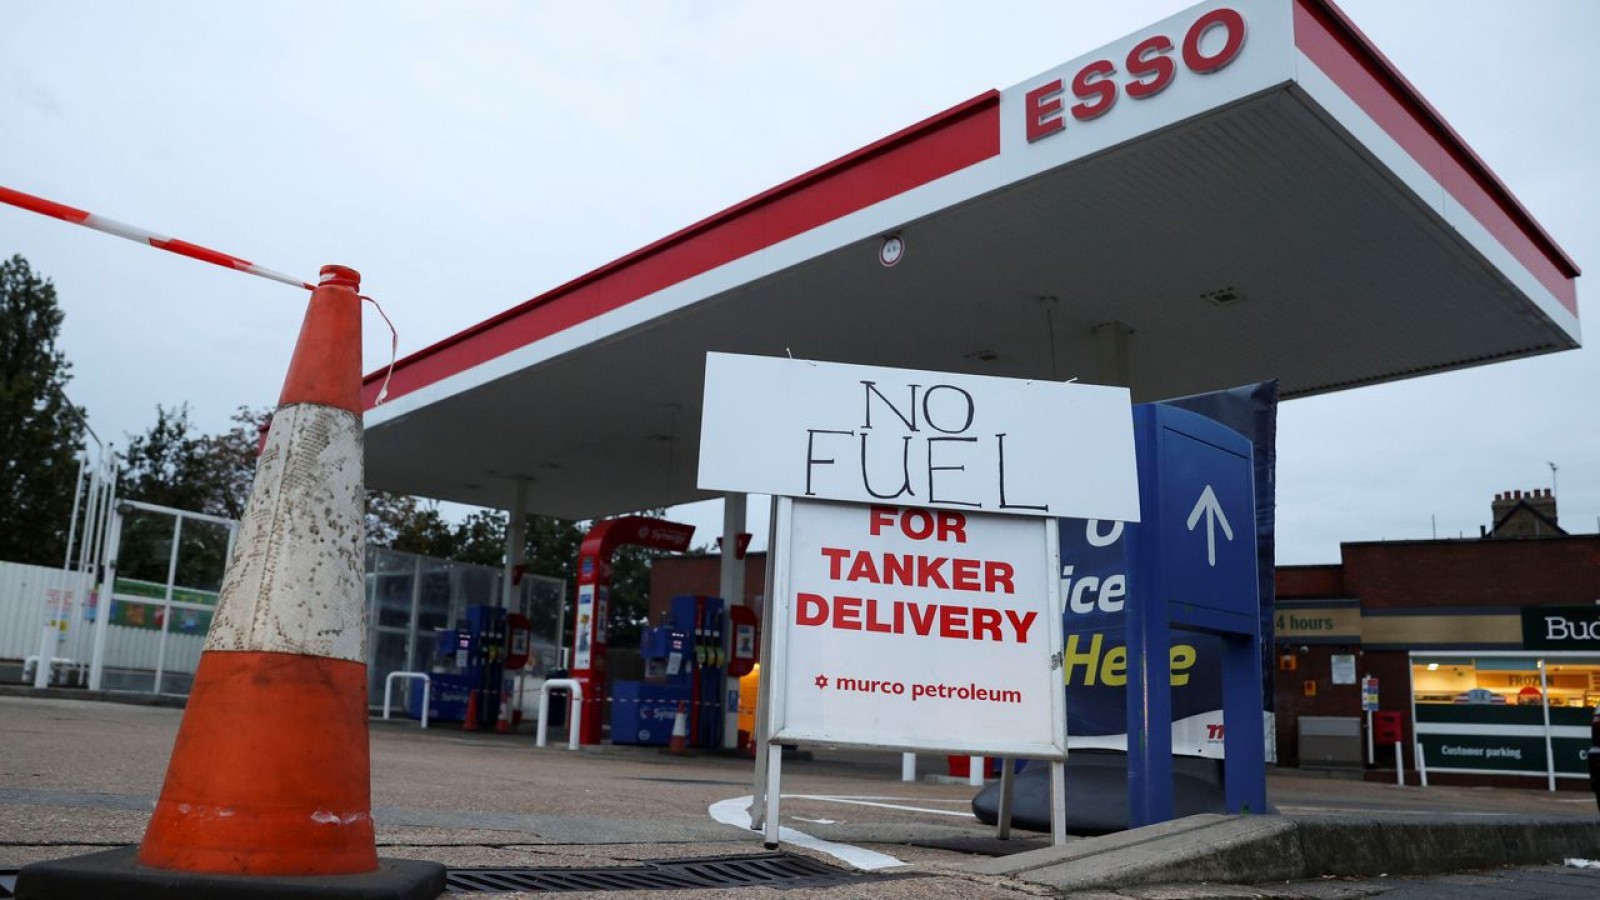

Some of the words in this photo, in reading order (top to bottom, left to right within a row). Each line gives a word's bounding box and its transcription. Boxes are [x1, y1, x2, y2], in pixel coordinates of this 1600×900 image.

[1026, 7, 1247, 144] ESSO
[860, 380, 975, 434] NO
[804, 430, 1049, 512] FUEL
[870, 505, 967, 543] FOR
[821, 547, 1015, 594] TANKER
[1060, 565, 1126, 615] ice
[796, 592, 1039, 643] DELIVERY
[1290, 615, 1334, 631] hours
[1065, 633, 1197, 686] Hee
[836, 676, 905, 694] murco
[911, 683, 1022, 703] petroleum
[1441, 744, 1484, 756] Customer
[1486, 746, 1522, 760] parking
